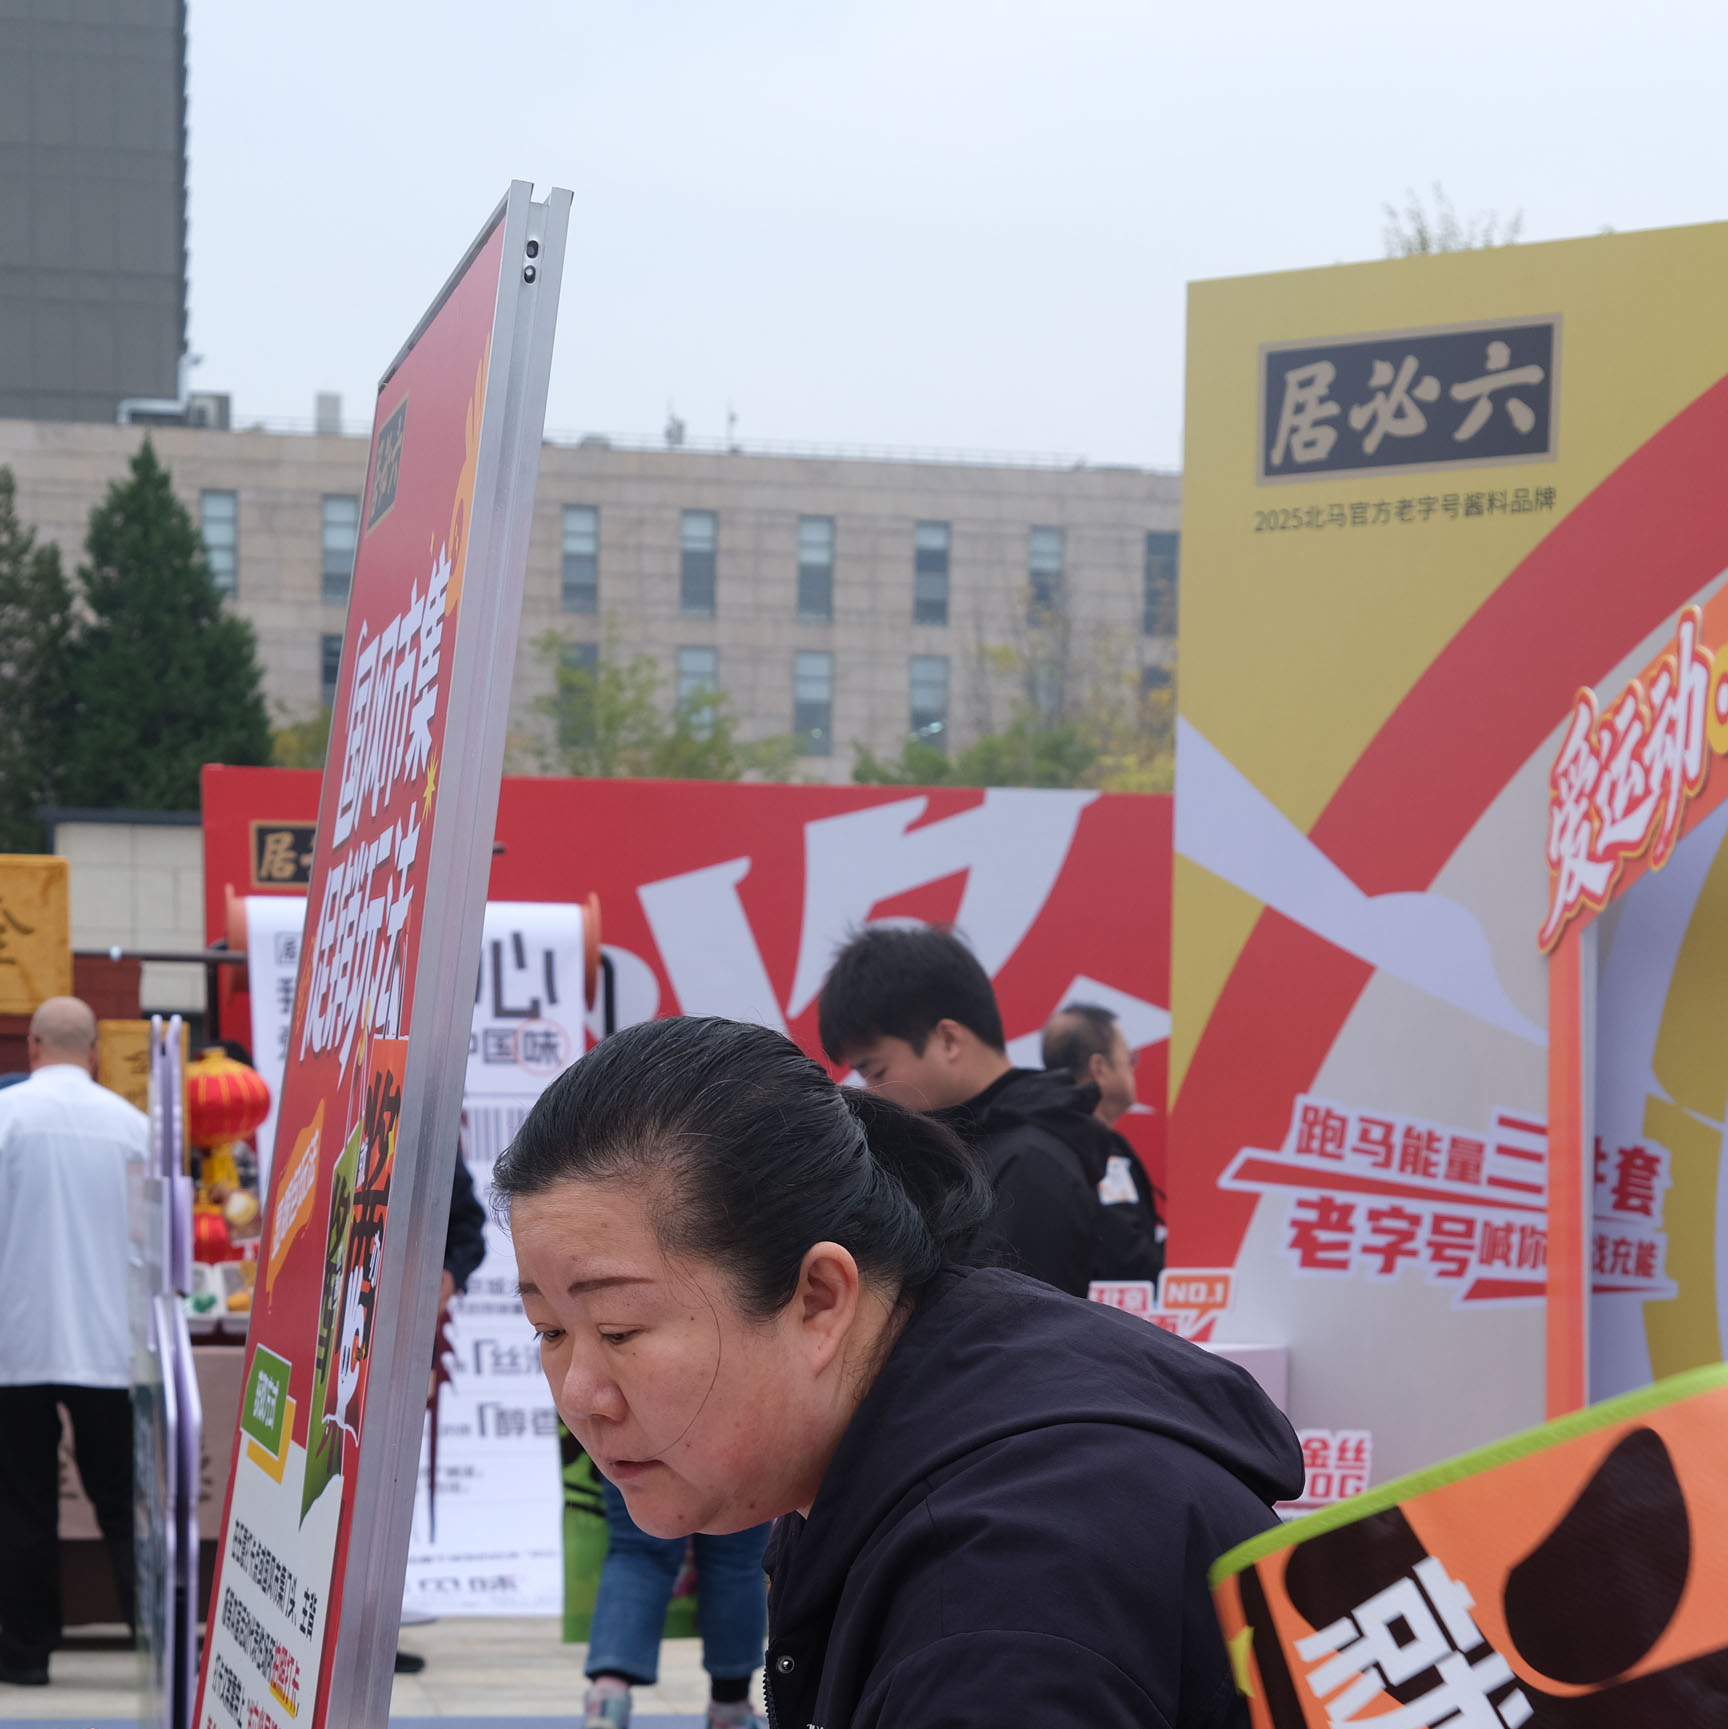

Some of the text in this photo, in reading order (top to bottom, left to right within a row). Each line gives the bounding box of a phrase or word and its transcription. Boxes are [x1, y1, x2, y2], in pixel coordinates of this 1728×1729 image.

[1253, 486, 1558, 534] 2025北马官方老字号酱料品牌
